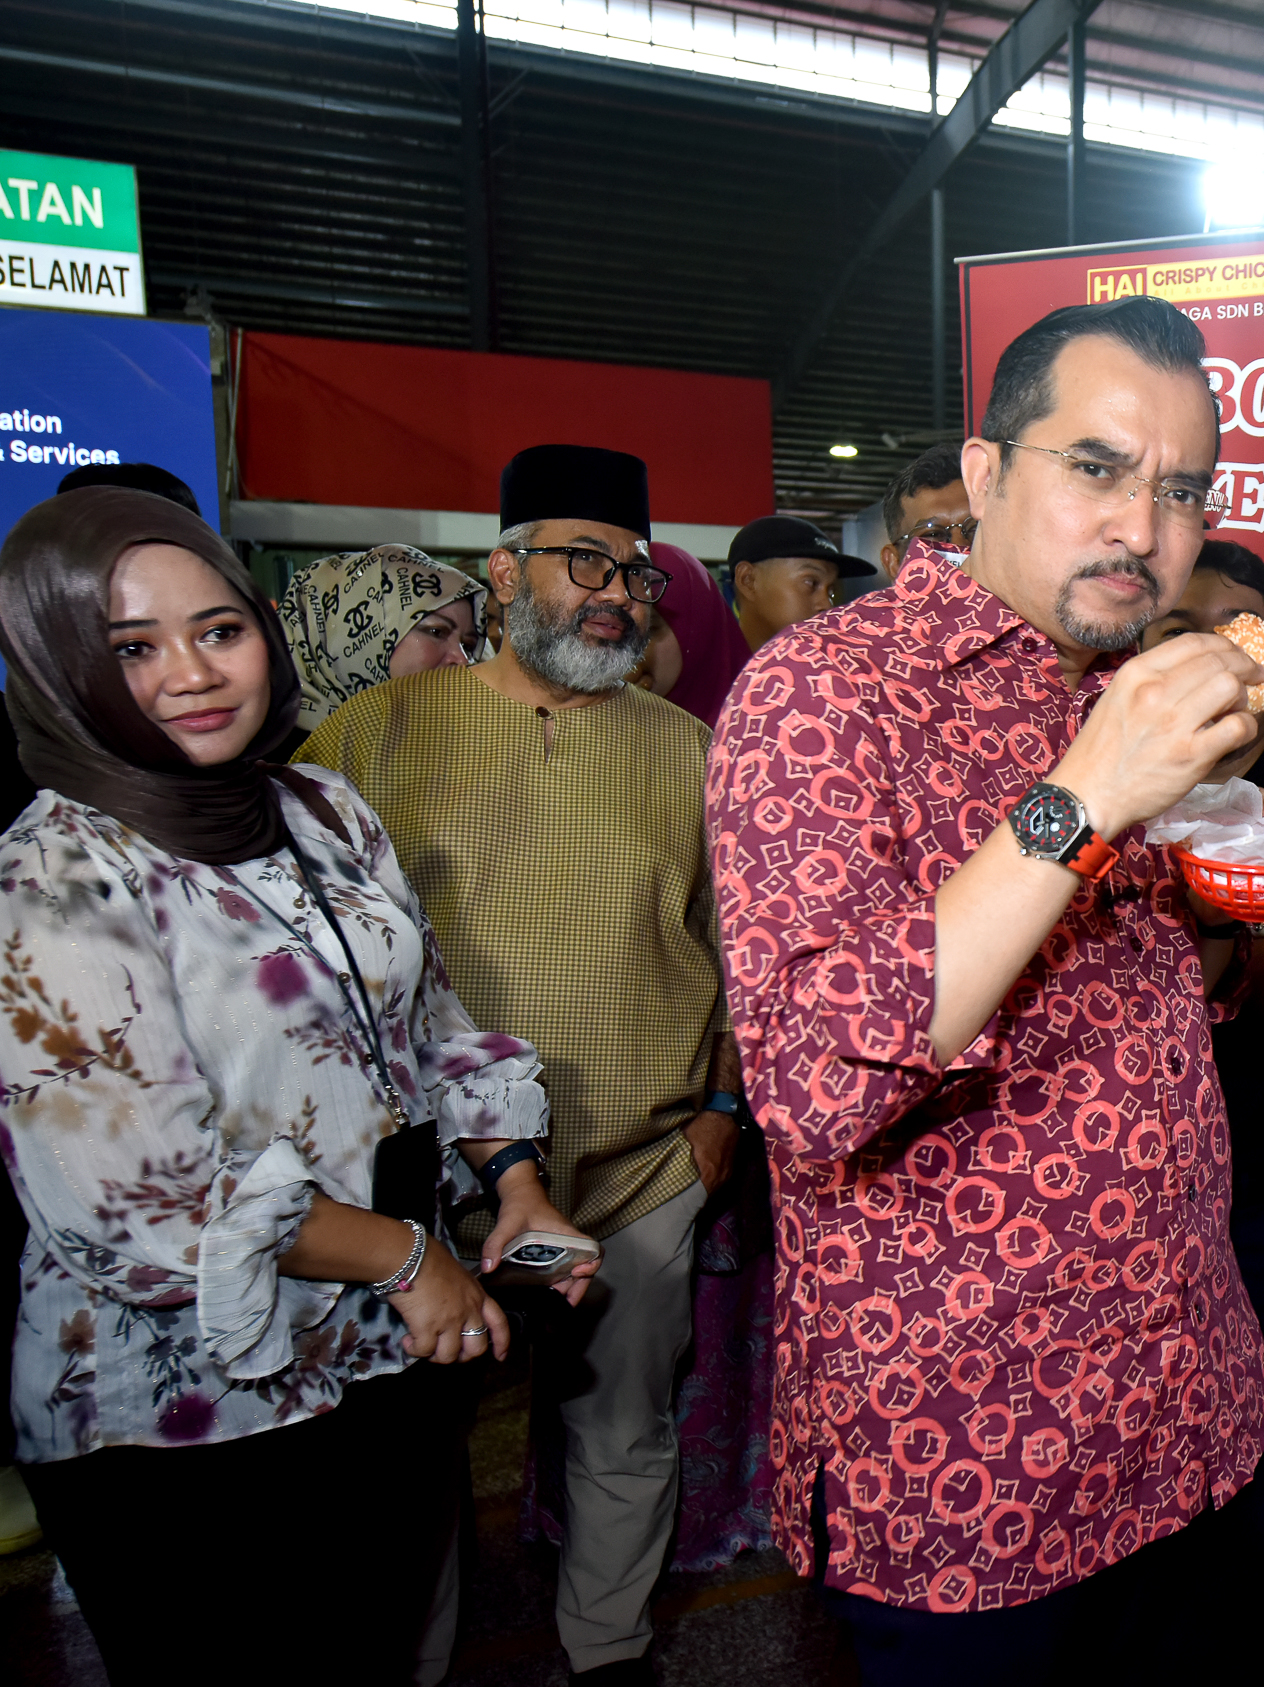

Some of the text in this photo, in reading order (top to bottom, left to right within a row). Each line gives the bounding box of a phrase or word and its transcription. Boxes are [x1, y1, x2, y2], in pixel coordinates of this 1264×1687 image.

[1093, 272, 1144, 302] HAI
[1153, 266, 1217, 287] CRISPY
[1217, 303, 1249, 320] SDN
[10, 439, 121, 466] Services
[396, 567, 412, 611] CAHNEL
[343, 621, 385, 658] CAHNEL
